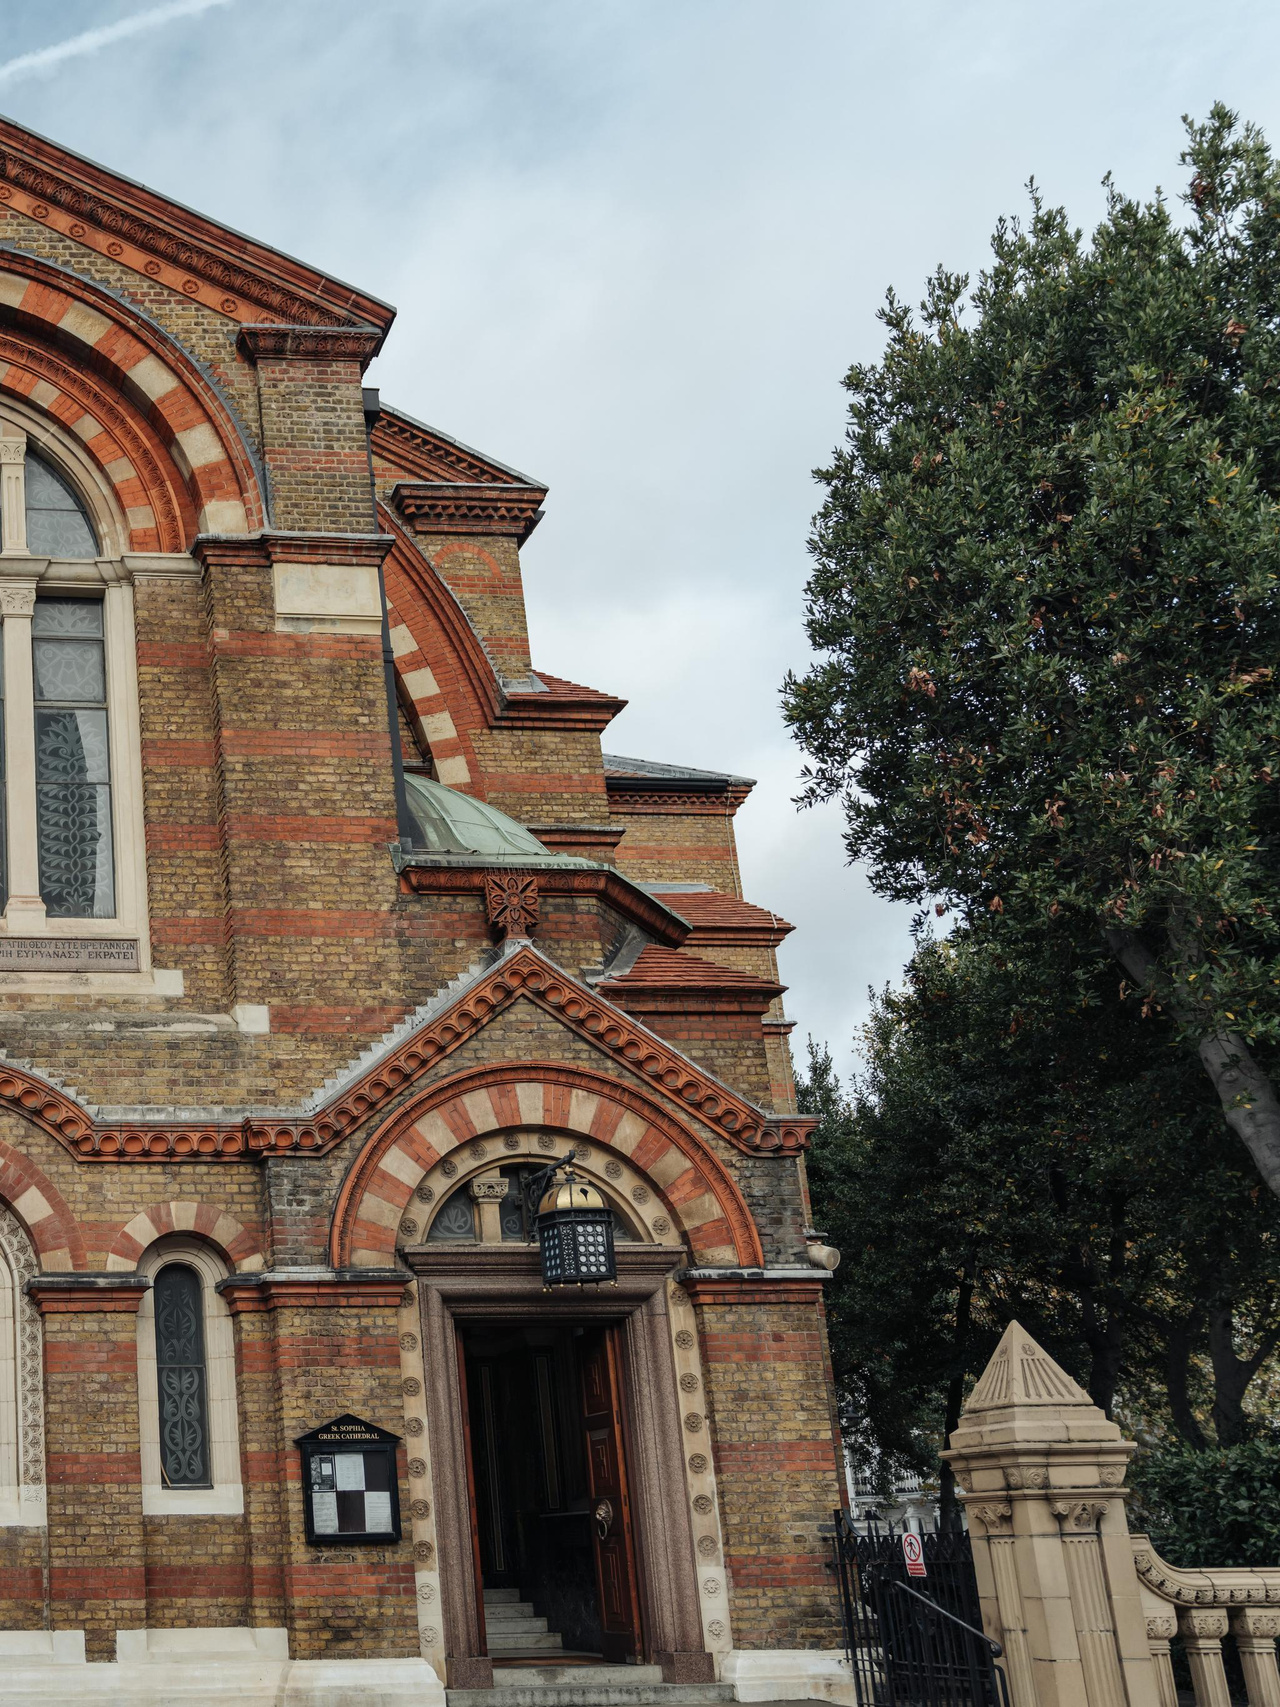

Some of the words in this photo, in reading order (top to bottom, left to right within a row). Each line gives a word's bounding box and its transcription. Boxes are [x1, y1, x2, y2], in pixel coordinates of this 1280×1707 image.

[29, 941, 52, 949] ΘΕΟΥ
[55, 941, 78, 949] ΕΥΤΕ
[80, 942, 135, 950] ΒΡΕΤΑΝΝΩΝ
